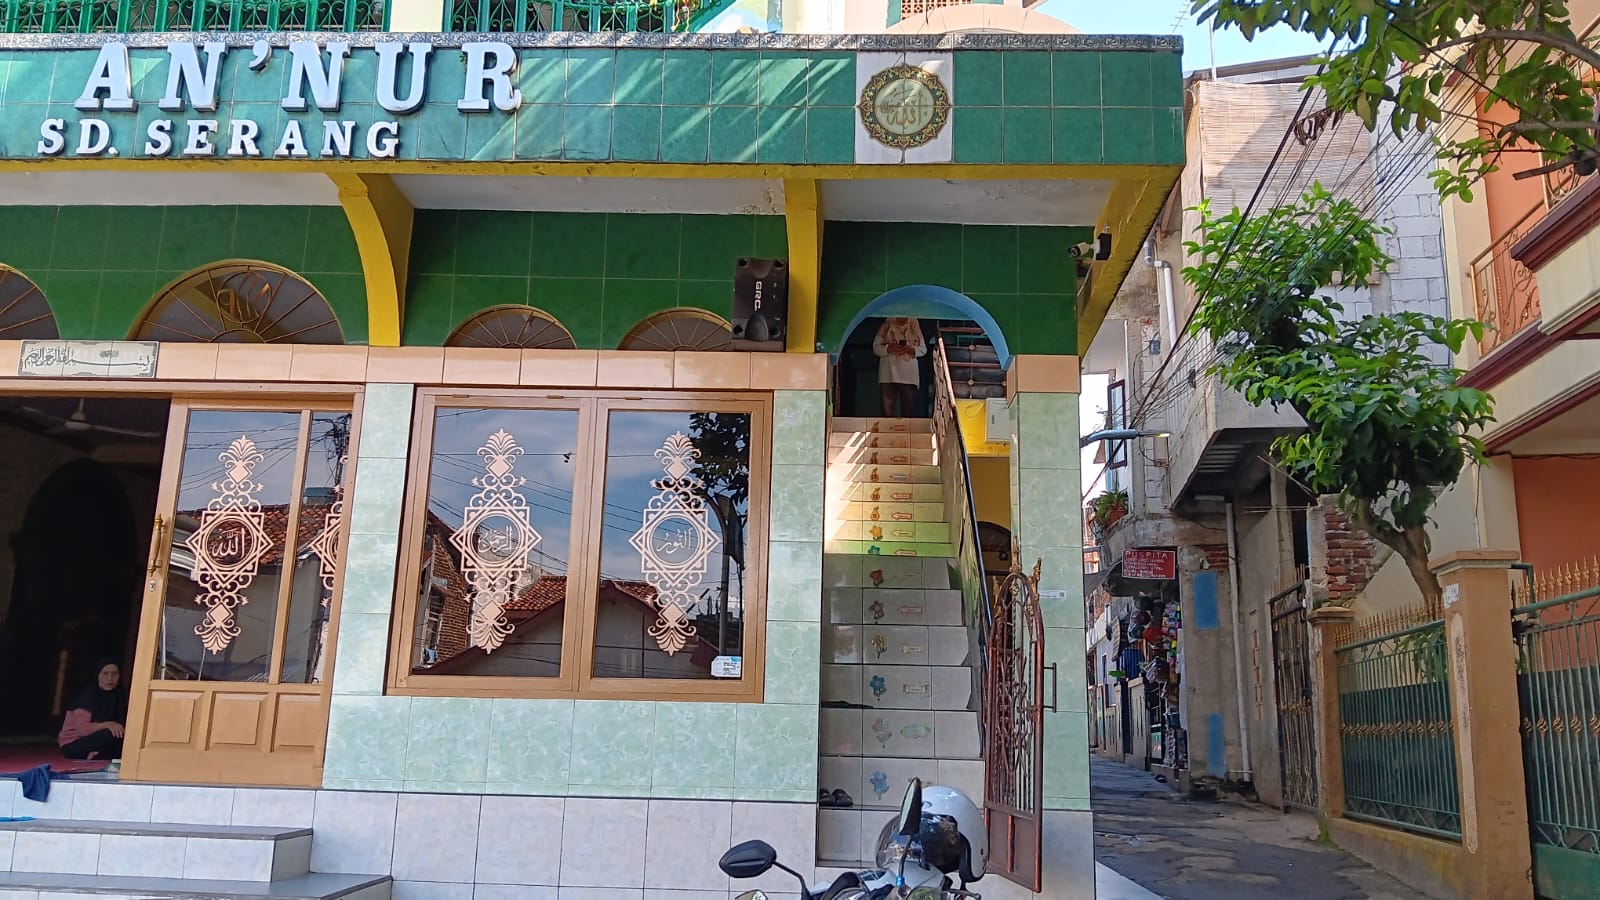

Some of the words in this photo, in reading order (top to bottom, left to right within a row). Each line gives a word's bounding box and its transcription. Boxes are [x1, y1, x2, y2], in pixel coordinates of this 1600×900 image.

[37, 117, 118, 155] SD.
[145, 118, 400, 158] SERANG
[1125, 550, 1168, 559] PUSPITA
